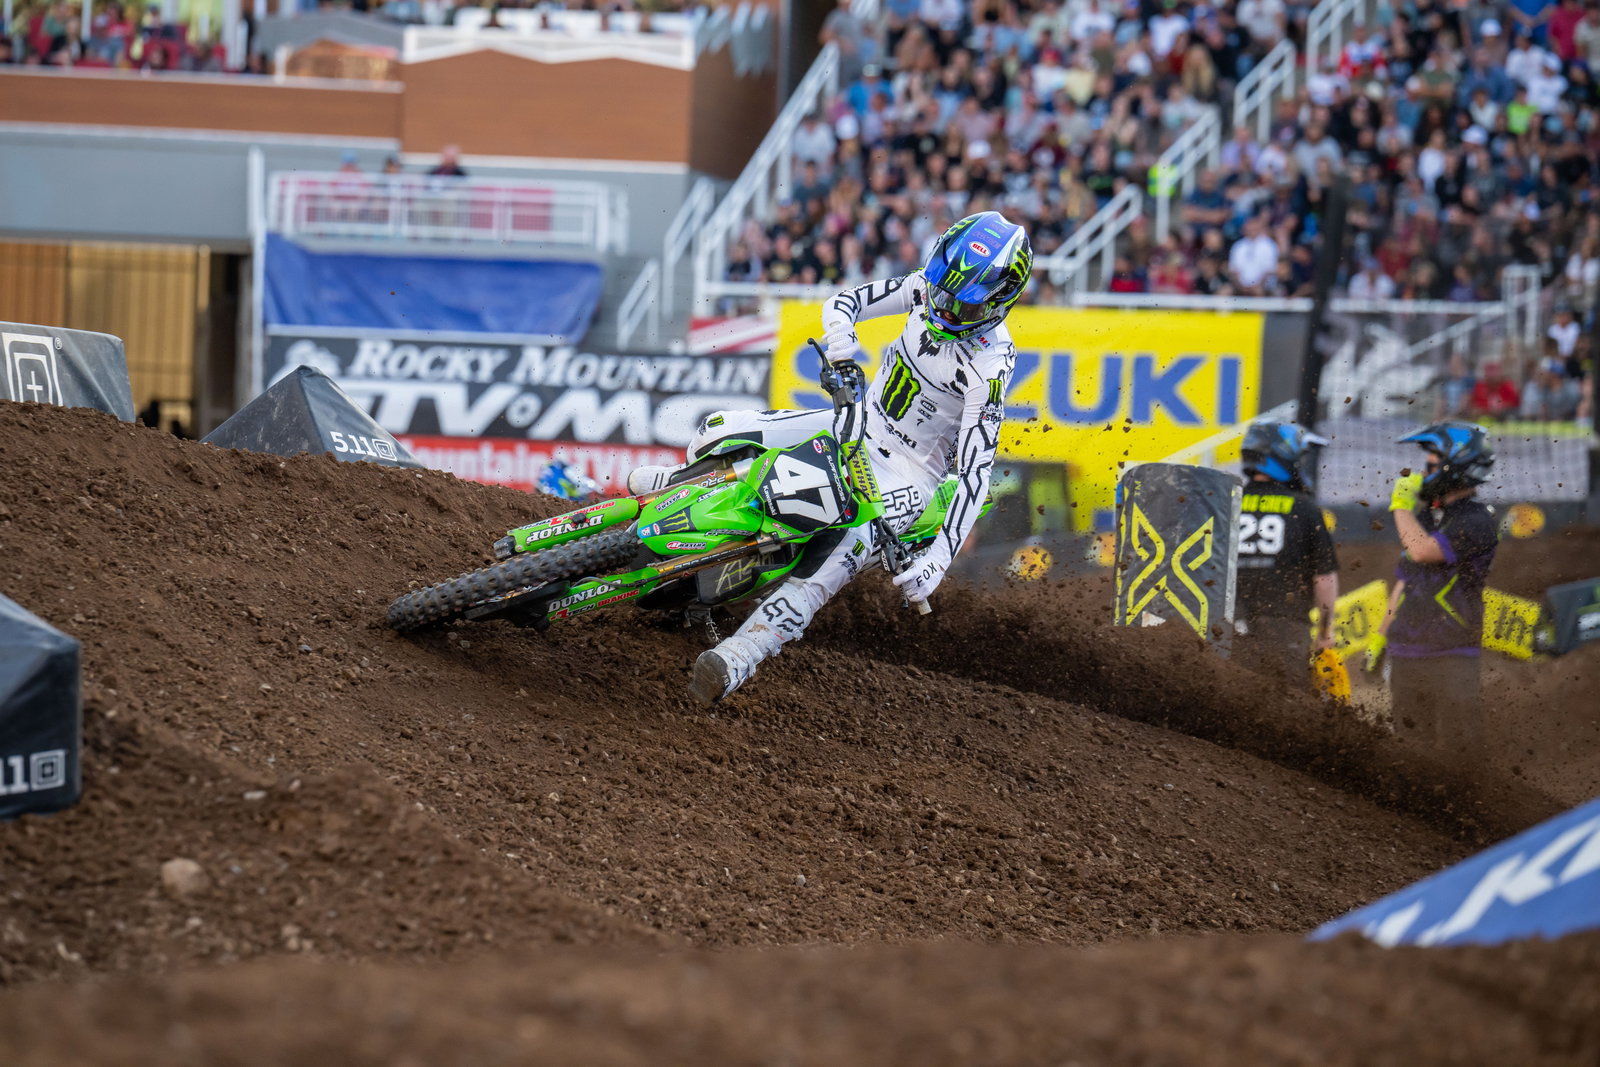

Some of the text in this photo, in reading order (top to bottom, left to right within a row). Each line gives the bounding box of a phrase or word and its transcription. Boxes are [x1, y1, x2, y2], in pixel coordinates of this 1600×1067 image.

[971, 243, 988, 256] BELL
[345, 340, 769, 393] ROCKY MOUNTAIN
[794, 344, 1240, 424] SZUKI
[330, 431, 378, 457] 5.11
[762, 485, 778, 516] Kawasaki
[769, 454, 842, 525] 47
[1238, 513, 1286, 555] 29
[916, 562, 938, 587] FOX
[597, 589, 640, 608] BRAKING
